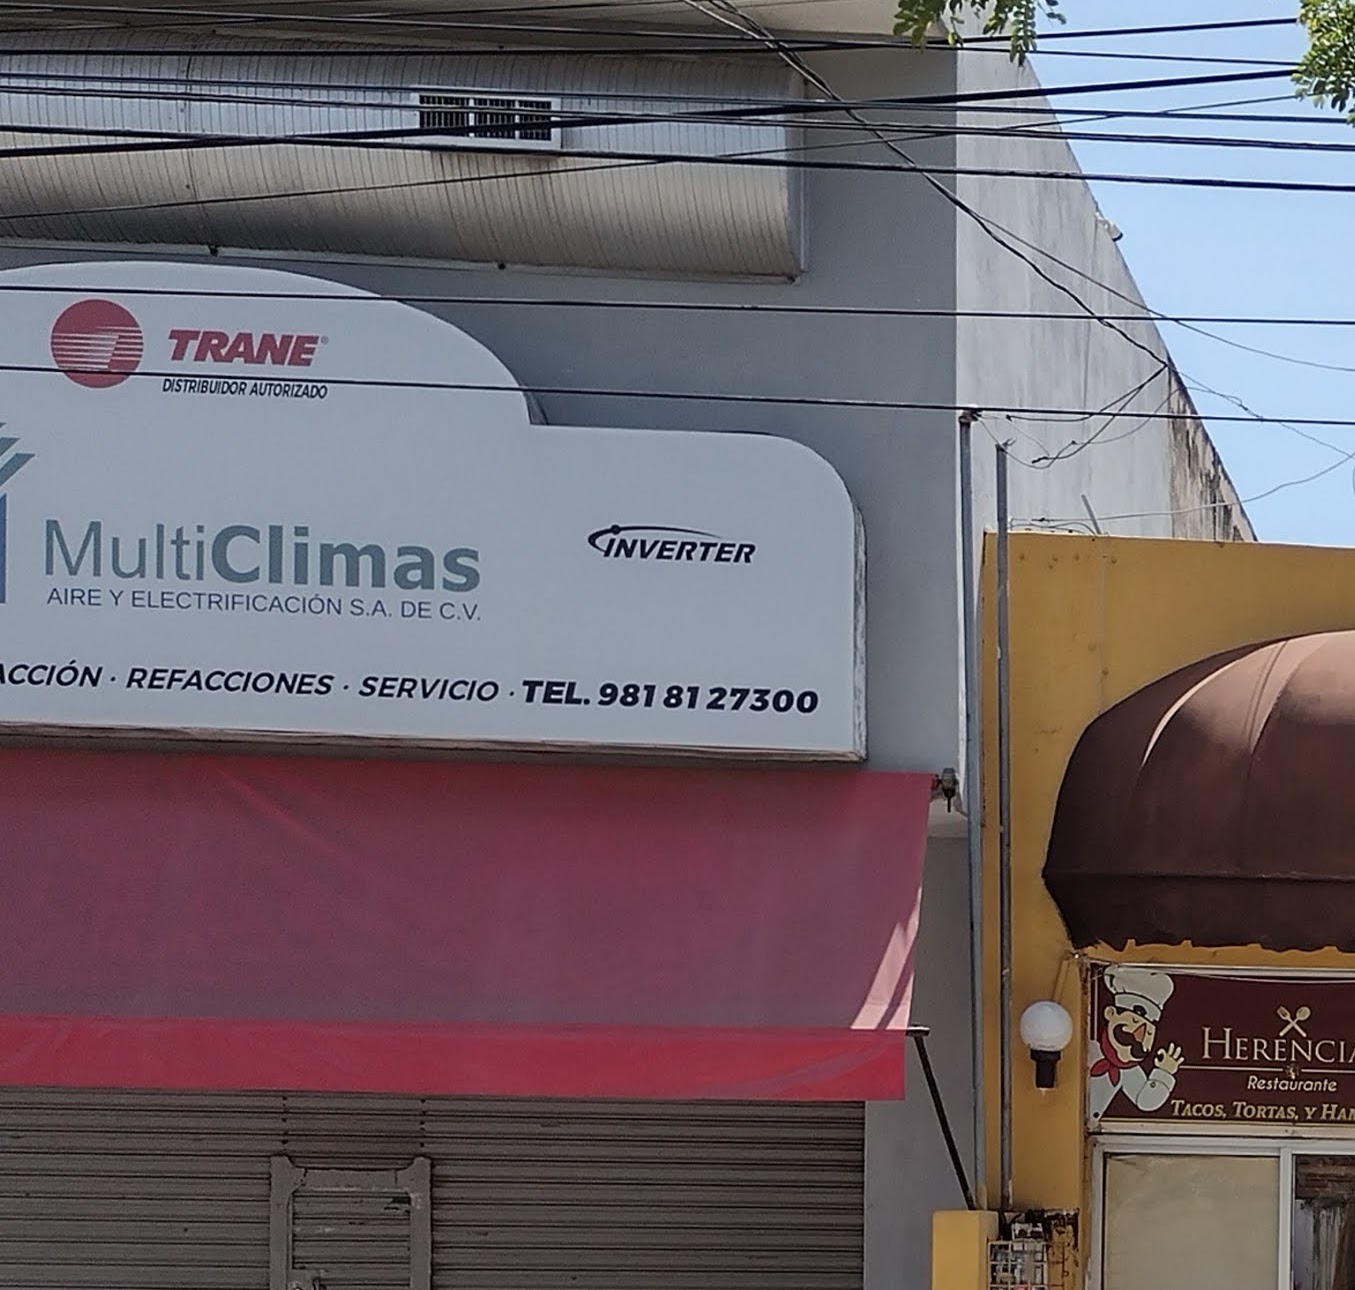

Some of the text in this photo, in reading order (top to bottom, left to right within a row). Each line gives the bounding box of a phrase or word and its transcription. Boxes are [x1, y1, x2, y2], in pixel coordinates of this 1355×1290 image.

[168, 328, 320, 367] TRANE
[162, 378, 328, 399] DISTRIBUIDOR AUTORIZADO
[45, 519, 480, 592] MultiClimas
[603, 538, 756, 563] INVERTER
[47, 588, 481, 622] AIRE Y ELECTRIFICACIÓN S.A. DE C.V.
[126, 667, 334, 695] REFACCIONES
[359, 676, 499, 702] SERVICIO
[523, 679, 590, 706] TEL.
[706, 687, 819, 714] 27300
[1247, 1075, 1338, 1093] Restaurante
[1170, 1100, 1228, 1119] TACOS,
[1234, 1101, 1299, 1121] TORTAS,
